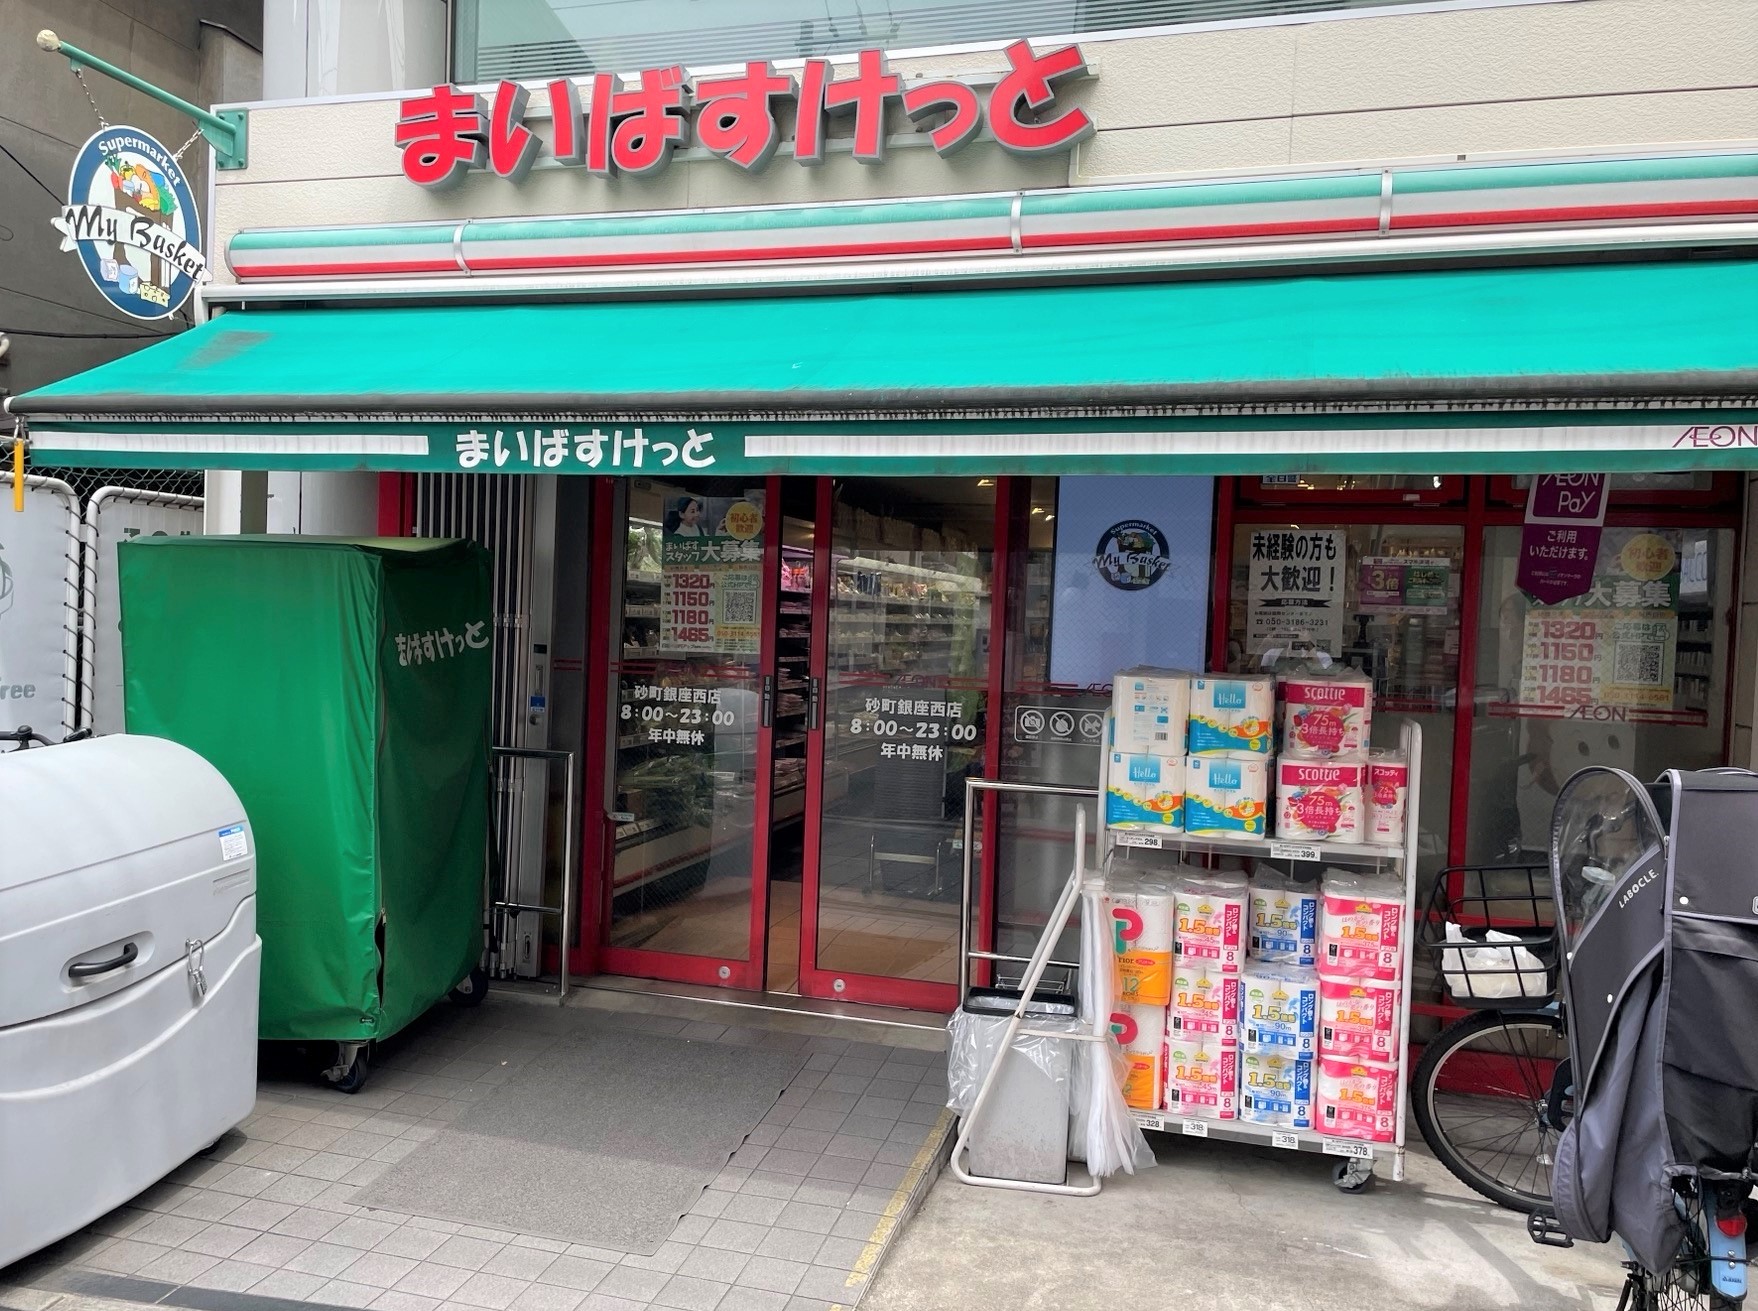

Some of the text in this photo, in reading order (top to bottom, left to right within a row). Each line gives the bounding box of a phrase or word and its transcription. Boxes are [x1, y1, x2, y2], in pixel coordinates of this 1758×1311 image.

[394, 38, 1098, 190] まいばすけっと
[98, 135, 182, 188] Supermarket
[65, 205, 204, 281] My Basket
[455, 428, 717, 468] まいばすけっと
[1110, 522, 1158, 535] Supermarket
[1547, 529, 1578, 544] ご利用
[701, 540, 761, 562] 大募集
[1252, 532, 1336, 561] 未経験の方も
[1529, 545, 1589, 561] いただけます。
[1584, 580, 1672, 608] 大募集
[634, 685, 722, 704] 砂町銀座西店
[1217, 693, 1242, 705] Hello
[865, 697, 963, 718] 砂町銀座西店
[1313, 714, 1337, 726] 75m
[648, 728, 705, 746] 年中無休
[880, 742, 944, 762] 年中無休
[1133, 766, 1156, 779] Hello
[1373, 768, 1399, 777] スコッティ
[1213, 773, 1237, 785] Hello
[1308, 795, 1333, 806] 75m
[1296, 803, 1341, 816] 3倍長持ち
[1144, 838, 1158, 846] 298
[1301, 850, 1316, 859] 399
[1303, 944, 1311, 954] 8
[1226, 951, 1234, 961] 8
[1383, 952, 1392, 964] 8
[1225, 1025, 1233, 1036] 8
[1302, 1038, 1310, 1049] 8
[1376, 1036, 1386, 1048] 8
[1223, 1098, 1231, 1108] 8
[1297, 1105, 1306, 1116] 8
[1146, 1119, 1160, 1128] 328
[1380, 1116, 1389, 1128] 8
[1282, 1135, 1296, 1144] 318
[1353, 1146, 1368, 1156] 378
